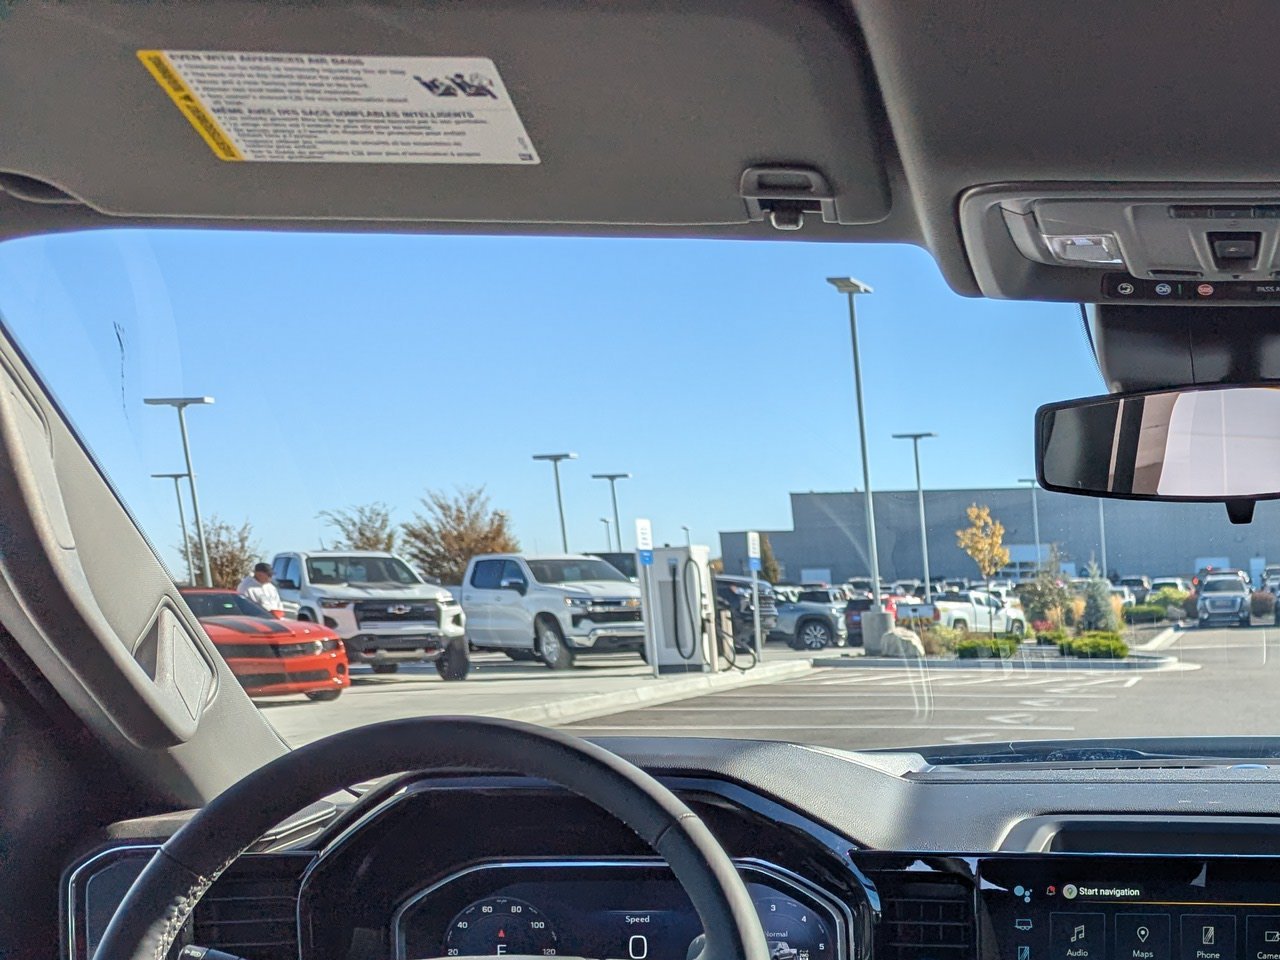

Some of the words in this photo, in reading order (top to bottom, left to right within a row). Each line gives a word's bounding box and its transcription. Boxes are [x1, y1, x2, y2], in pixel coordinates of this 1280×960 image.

[1079, 887, 1098, 896] Start
[1100, 887, 1140, 898] navigation
[625, 915, 651, 924] Speed
[629, 935, 648, 959] 0
[1066, 949, 1089, 957] Audio
[1132, 950, 1154, 958] Maps
[1196, 951, 1221, 959] Phone
